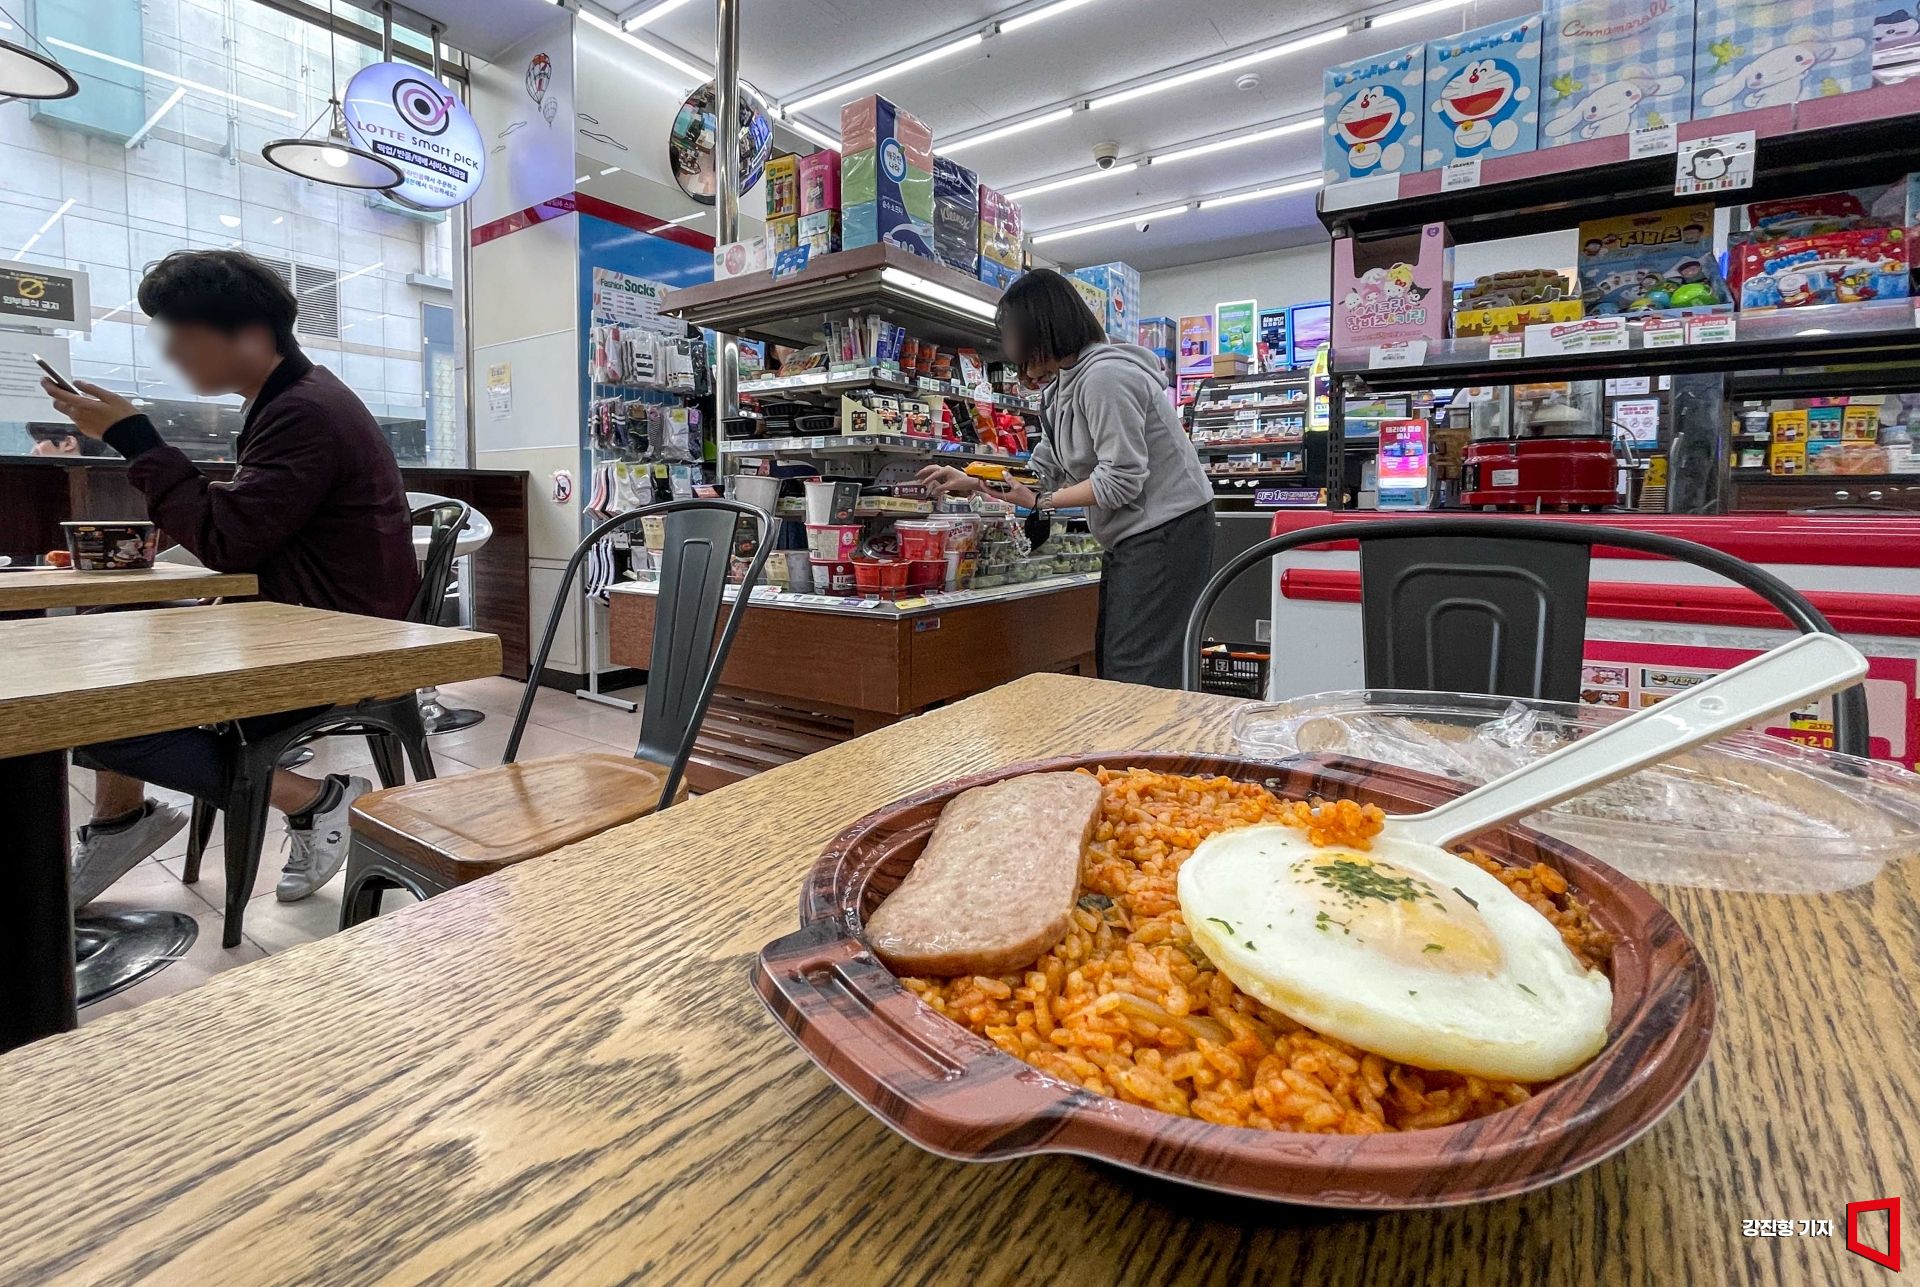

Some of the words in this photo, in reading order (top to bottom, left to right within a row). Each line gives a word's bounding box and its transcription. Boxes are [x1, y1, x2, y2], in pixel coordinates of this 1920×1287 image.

[357, 120, 406, 141] LOTTE
[411, 136, 451, 157] smart
[600, 278, 624, 291] Fashion
[624, 279, 656, 298] Socks
